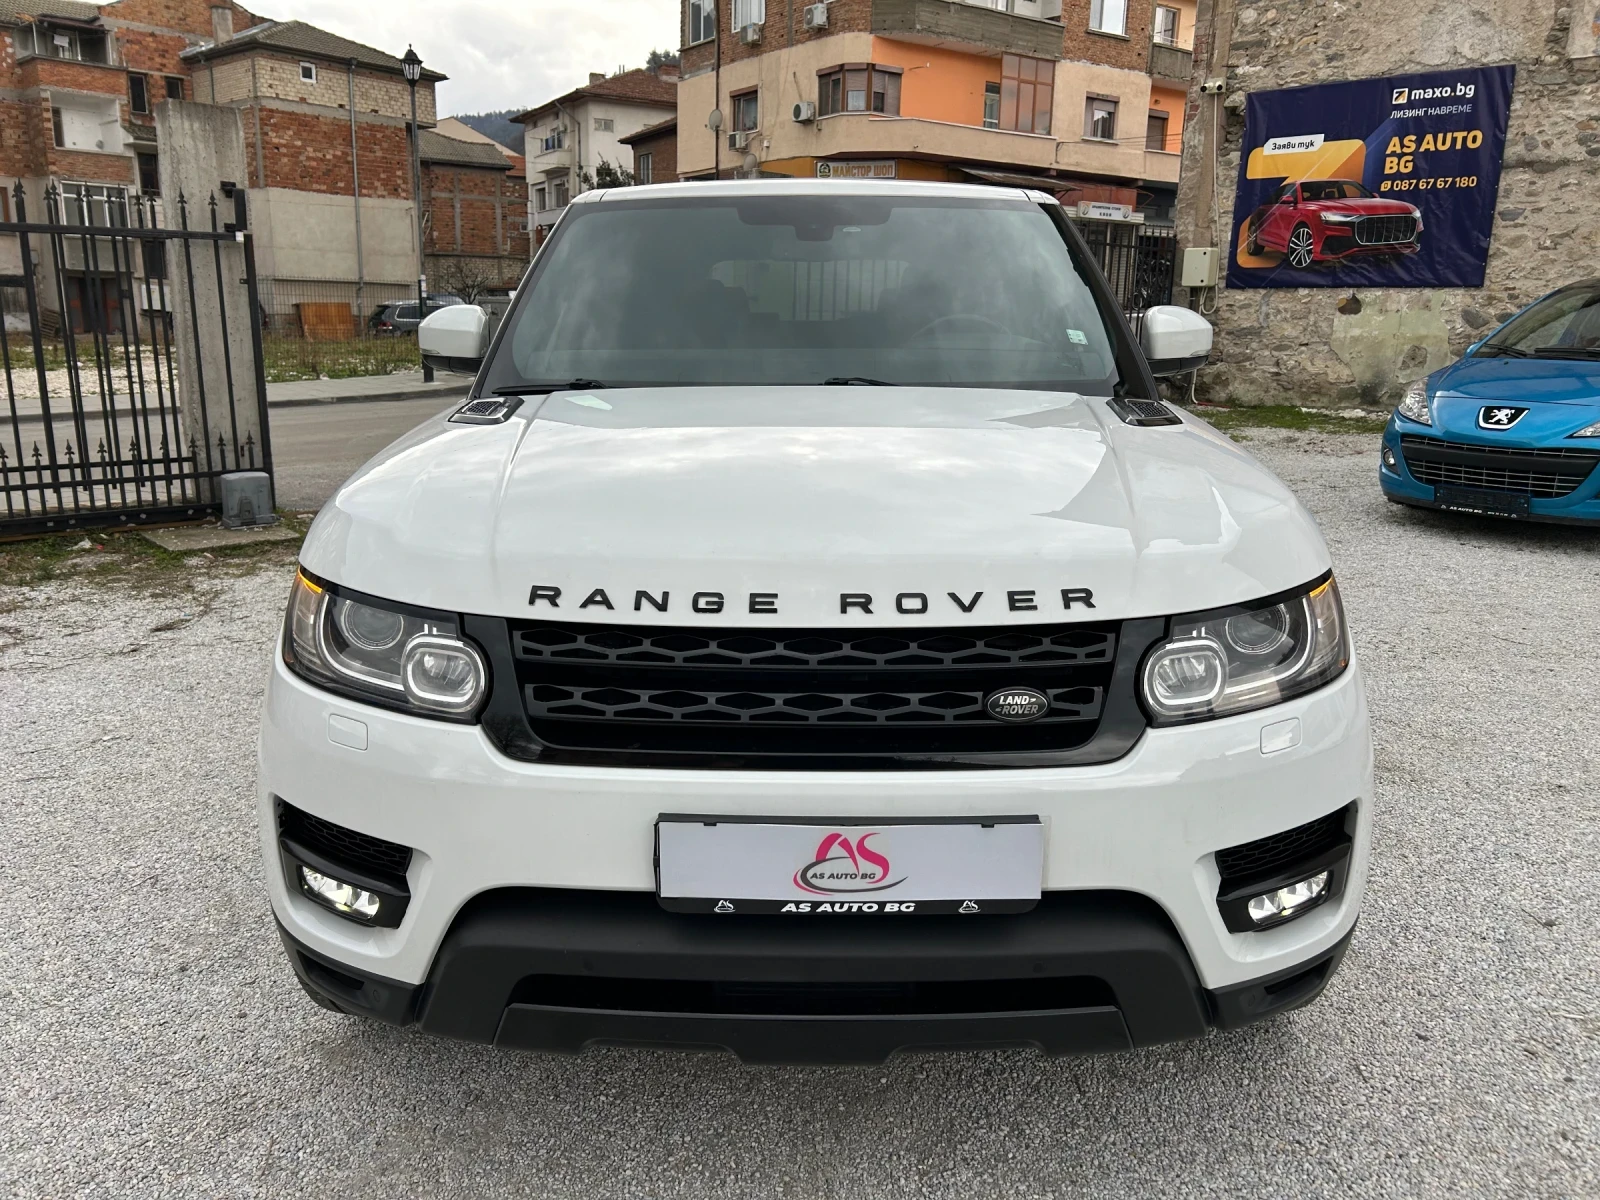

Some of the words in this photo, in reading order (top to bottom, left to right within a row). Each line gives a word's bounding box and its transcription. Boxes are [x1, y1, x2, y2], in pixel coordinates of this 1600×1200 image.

[1411, 82, 1475, 100] maxo.bg
[1390, 108, 1427, 119] ЛИЗИНГ
[1428, 104, 1472, 116] НАВРЕМЕ
[1271, 141, 1296, 151] Заяви
[1297, 139, 1316, 150] тук
[1385, 135, 1417, 154] AS
[1419, 130, 1483, 152] AUTO
[832, 162, 872, 177] МАЙСТОР
[873, 164, 893, 177] ШОП
[1384, 155, 1414, 174] BG
[1393, 180, 1417, 191] 087
[1418, 178, 1435, 190] 67
[1436, 177, 1453, 189] 67
[1455, 176, 1478, 188] 180
[528, 585, 778, 614] RANGE
[840, 587, 1096, 614] ROVER
[999, 696, 1029, 704] LAND
[1001, 704, 1039, 714] ROVER
[815, 832, 890, 884] AS
[810, 872, 825, 880] AS
[827, 872, 858, 880] AUTO
[860, 872, 876, 880] BG
[780, 902, 812, 913] AS
[815, 902, 880, 913] AUTO
[883, 902, 916, 913] BG
